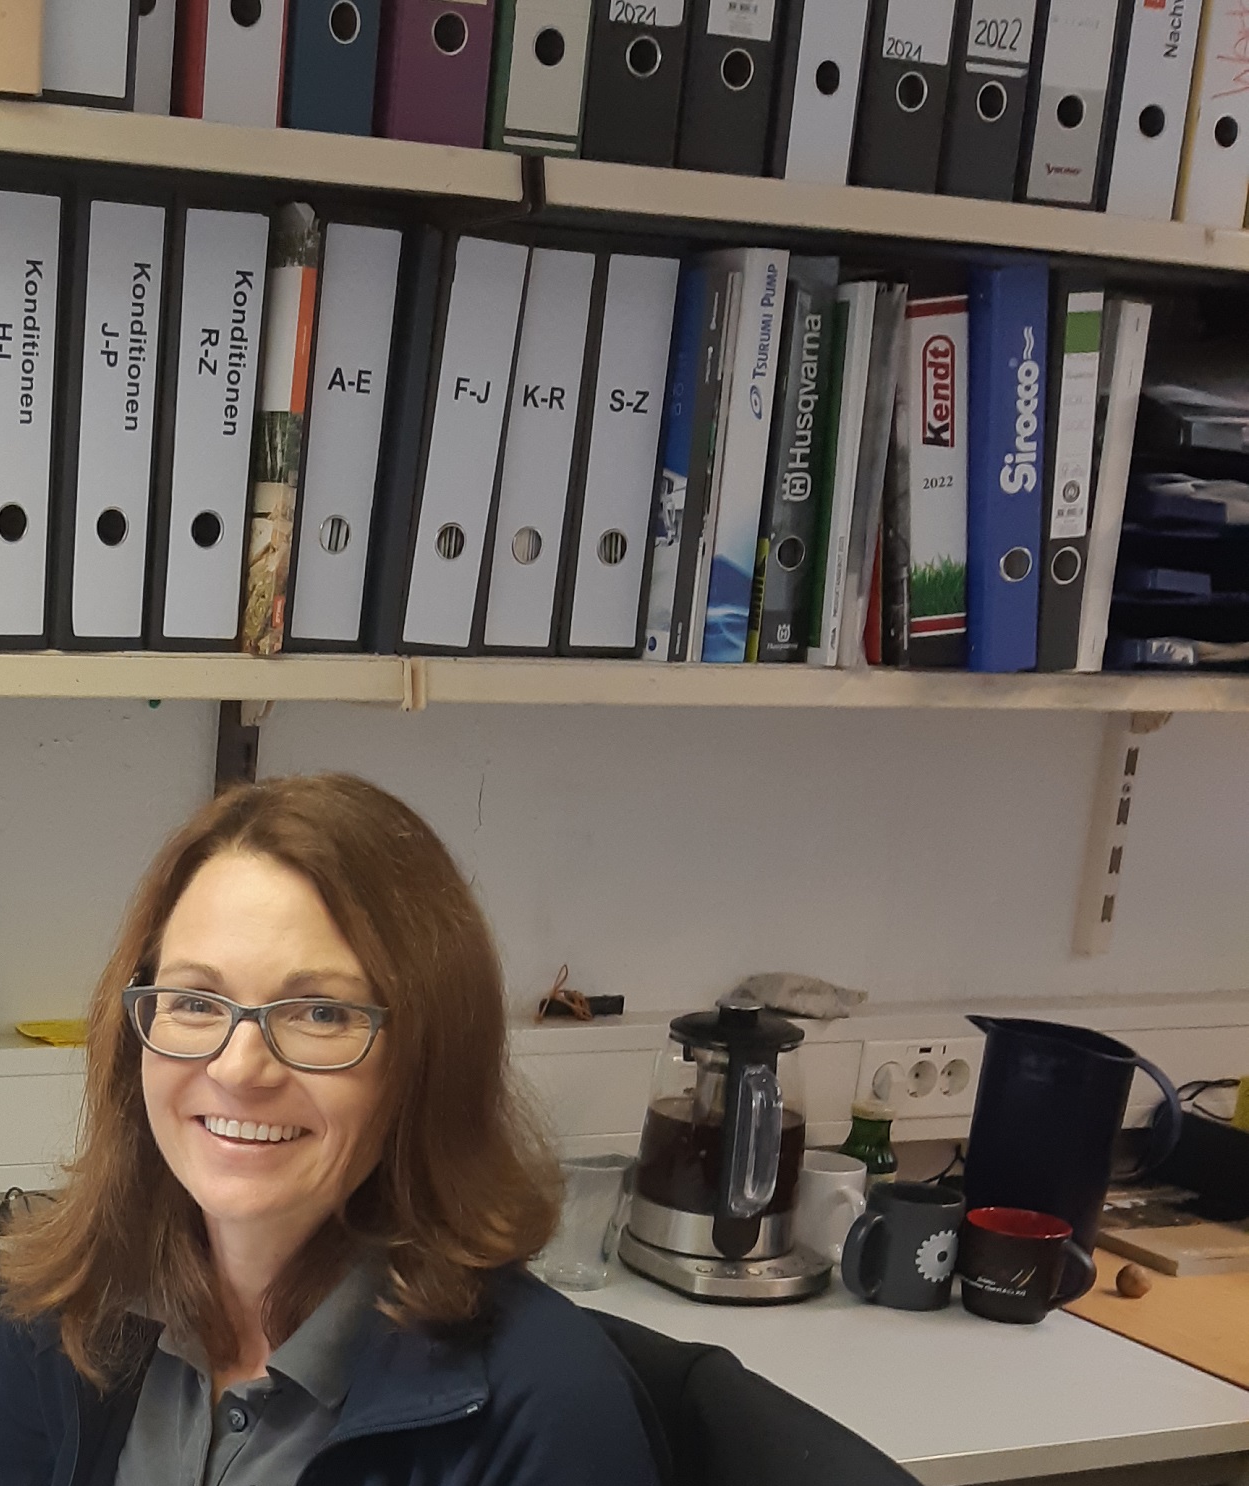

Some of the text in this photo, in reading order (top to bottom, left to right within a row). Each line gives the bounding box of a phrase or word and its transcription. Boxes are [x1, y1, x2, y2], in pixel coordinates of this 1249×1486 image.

[886, 37, 922, 61] 2021
[975, 18, 1022, 51] 2022
[19, 259, 43, 426] Konditionen
[100, 323, 119, 367] J-P
[124, 262, 151, 432] Konditionen
[197, 327, 220, 376] R-Z
[222, 269, 254, 437] Konditionen
[327, 367, 372, 394] A-E
[454, 377, 491, 404] F-J
[522, 384, 566, 410] K-R
[609, 389, 649, 414] S-Z
[788, 313, 823, 471] Husqvarna
[923, 340, 955, 446] Kendt
[1000, 359, 1040, 493] Sirocco
[922, 475, 954, 491] 2022
